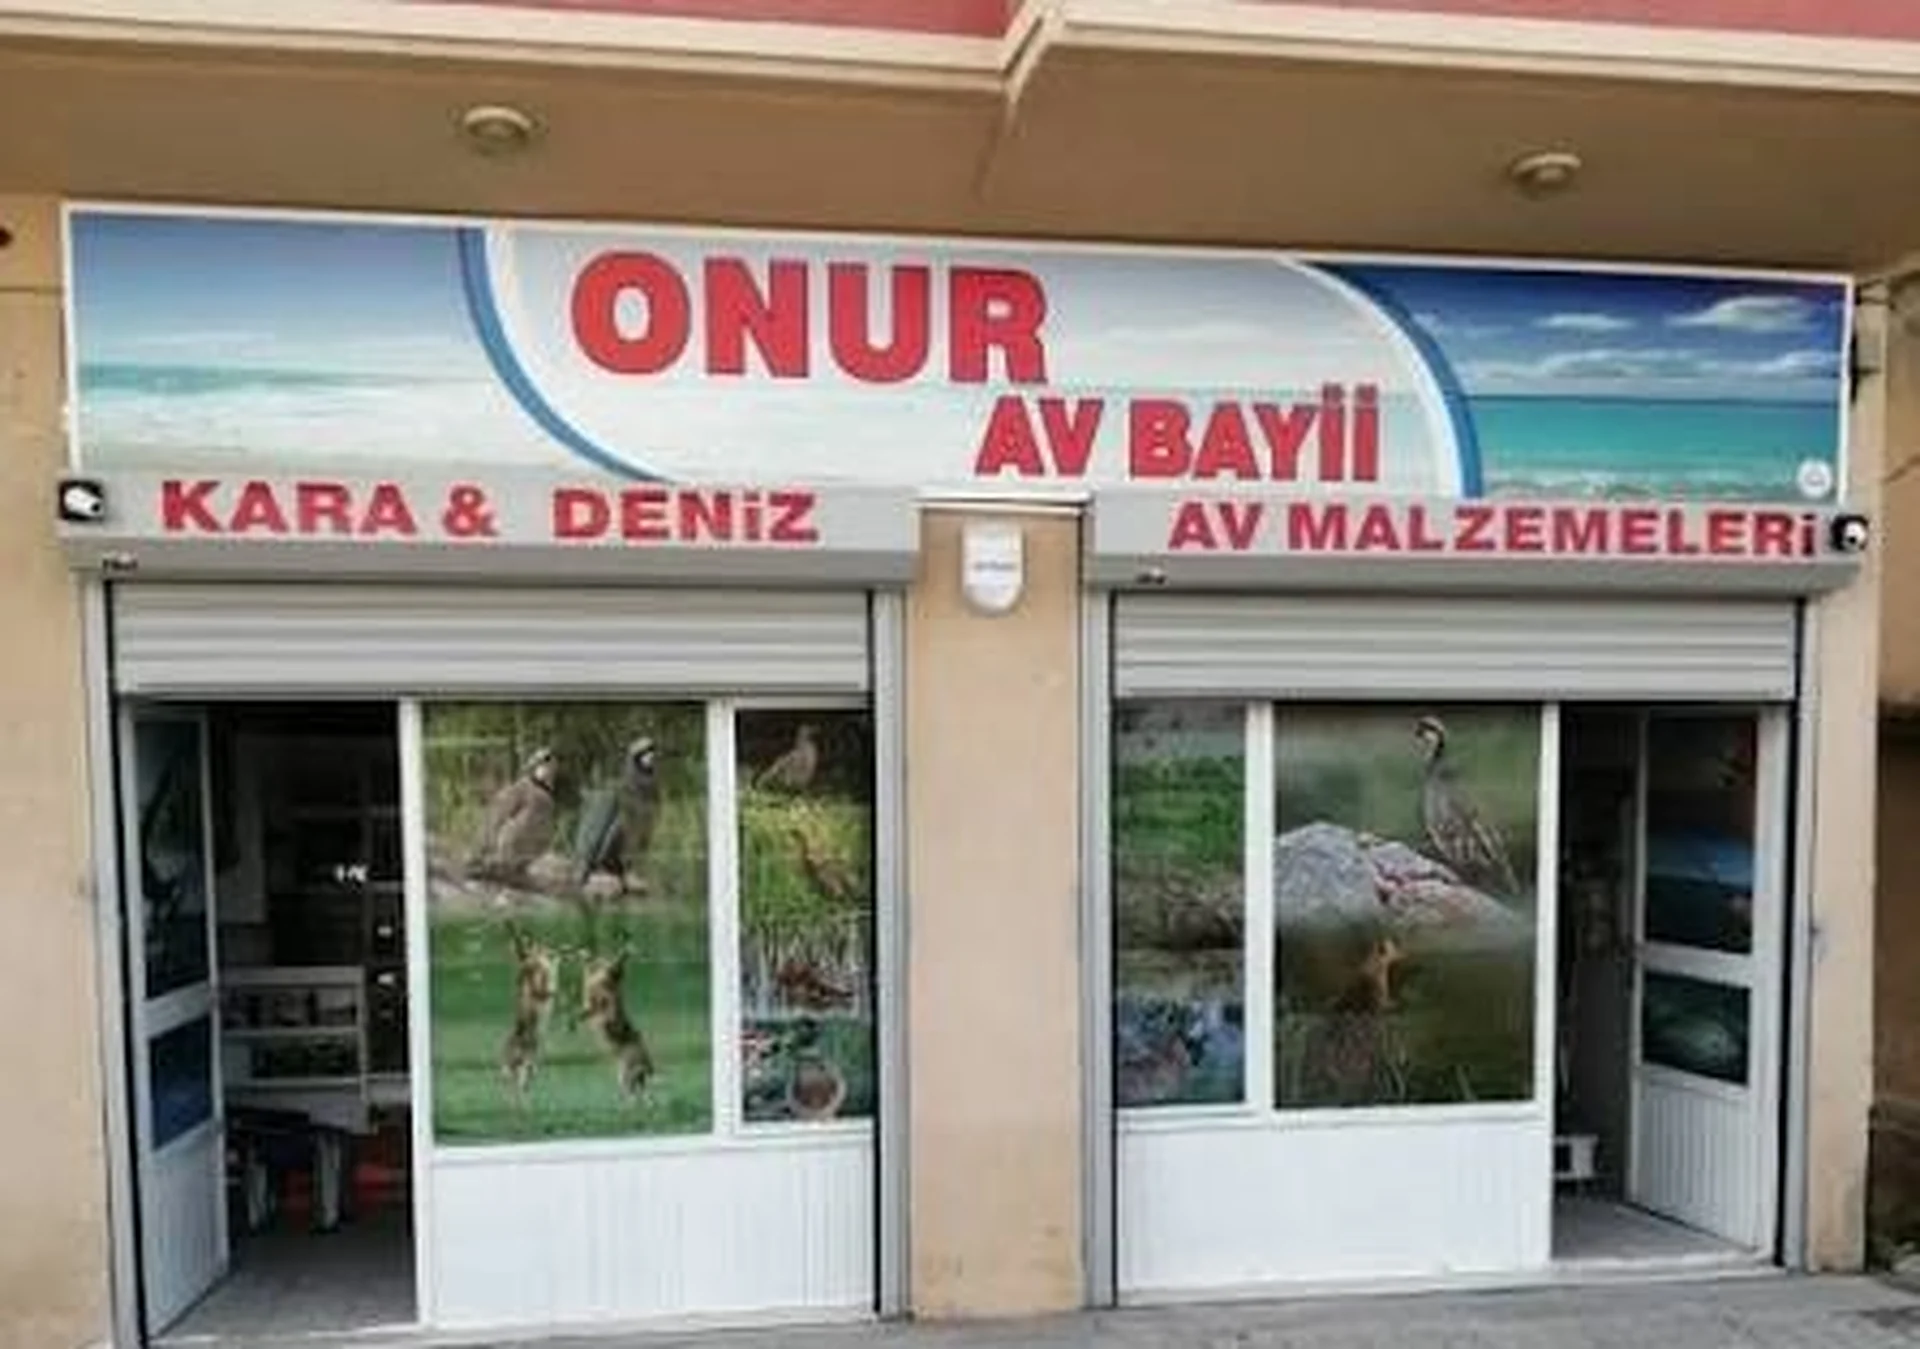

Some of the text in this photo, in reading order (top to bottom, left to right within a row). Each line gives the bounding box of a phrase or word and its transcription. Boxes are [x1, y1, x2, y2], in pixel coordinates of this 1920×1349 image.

[571, 250, 1047, 385] ONUR
[975, 395, 1103, 477] AV
[161, 481, 417, 535] KARA
[443, 487, 496, 538] &
[1168, 503, 1262, 551] AV
